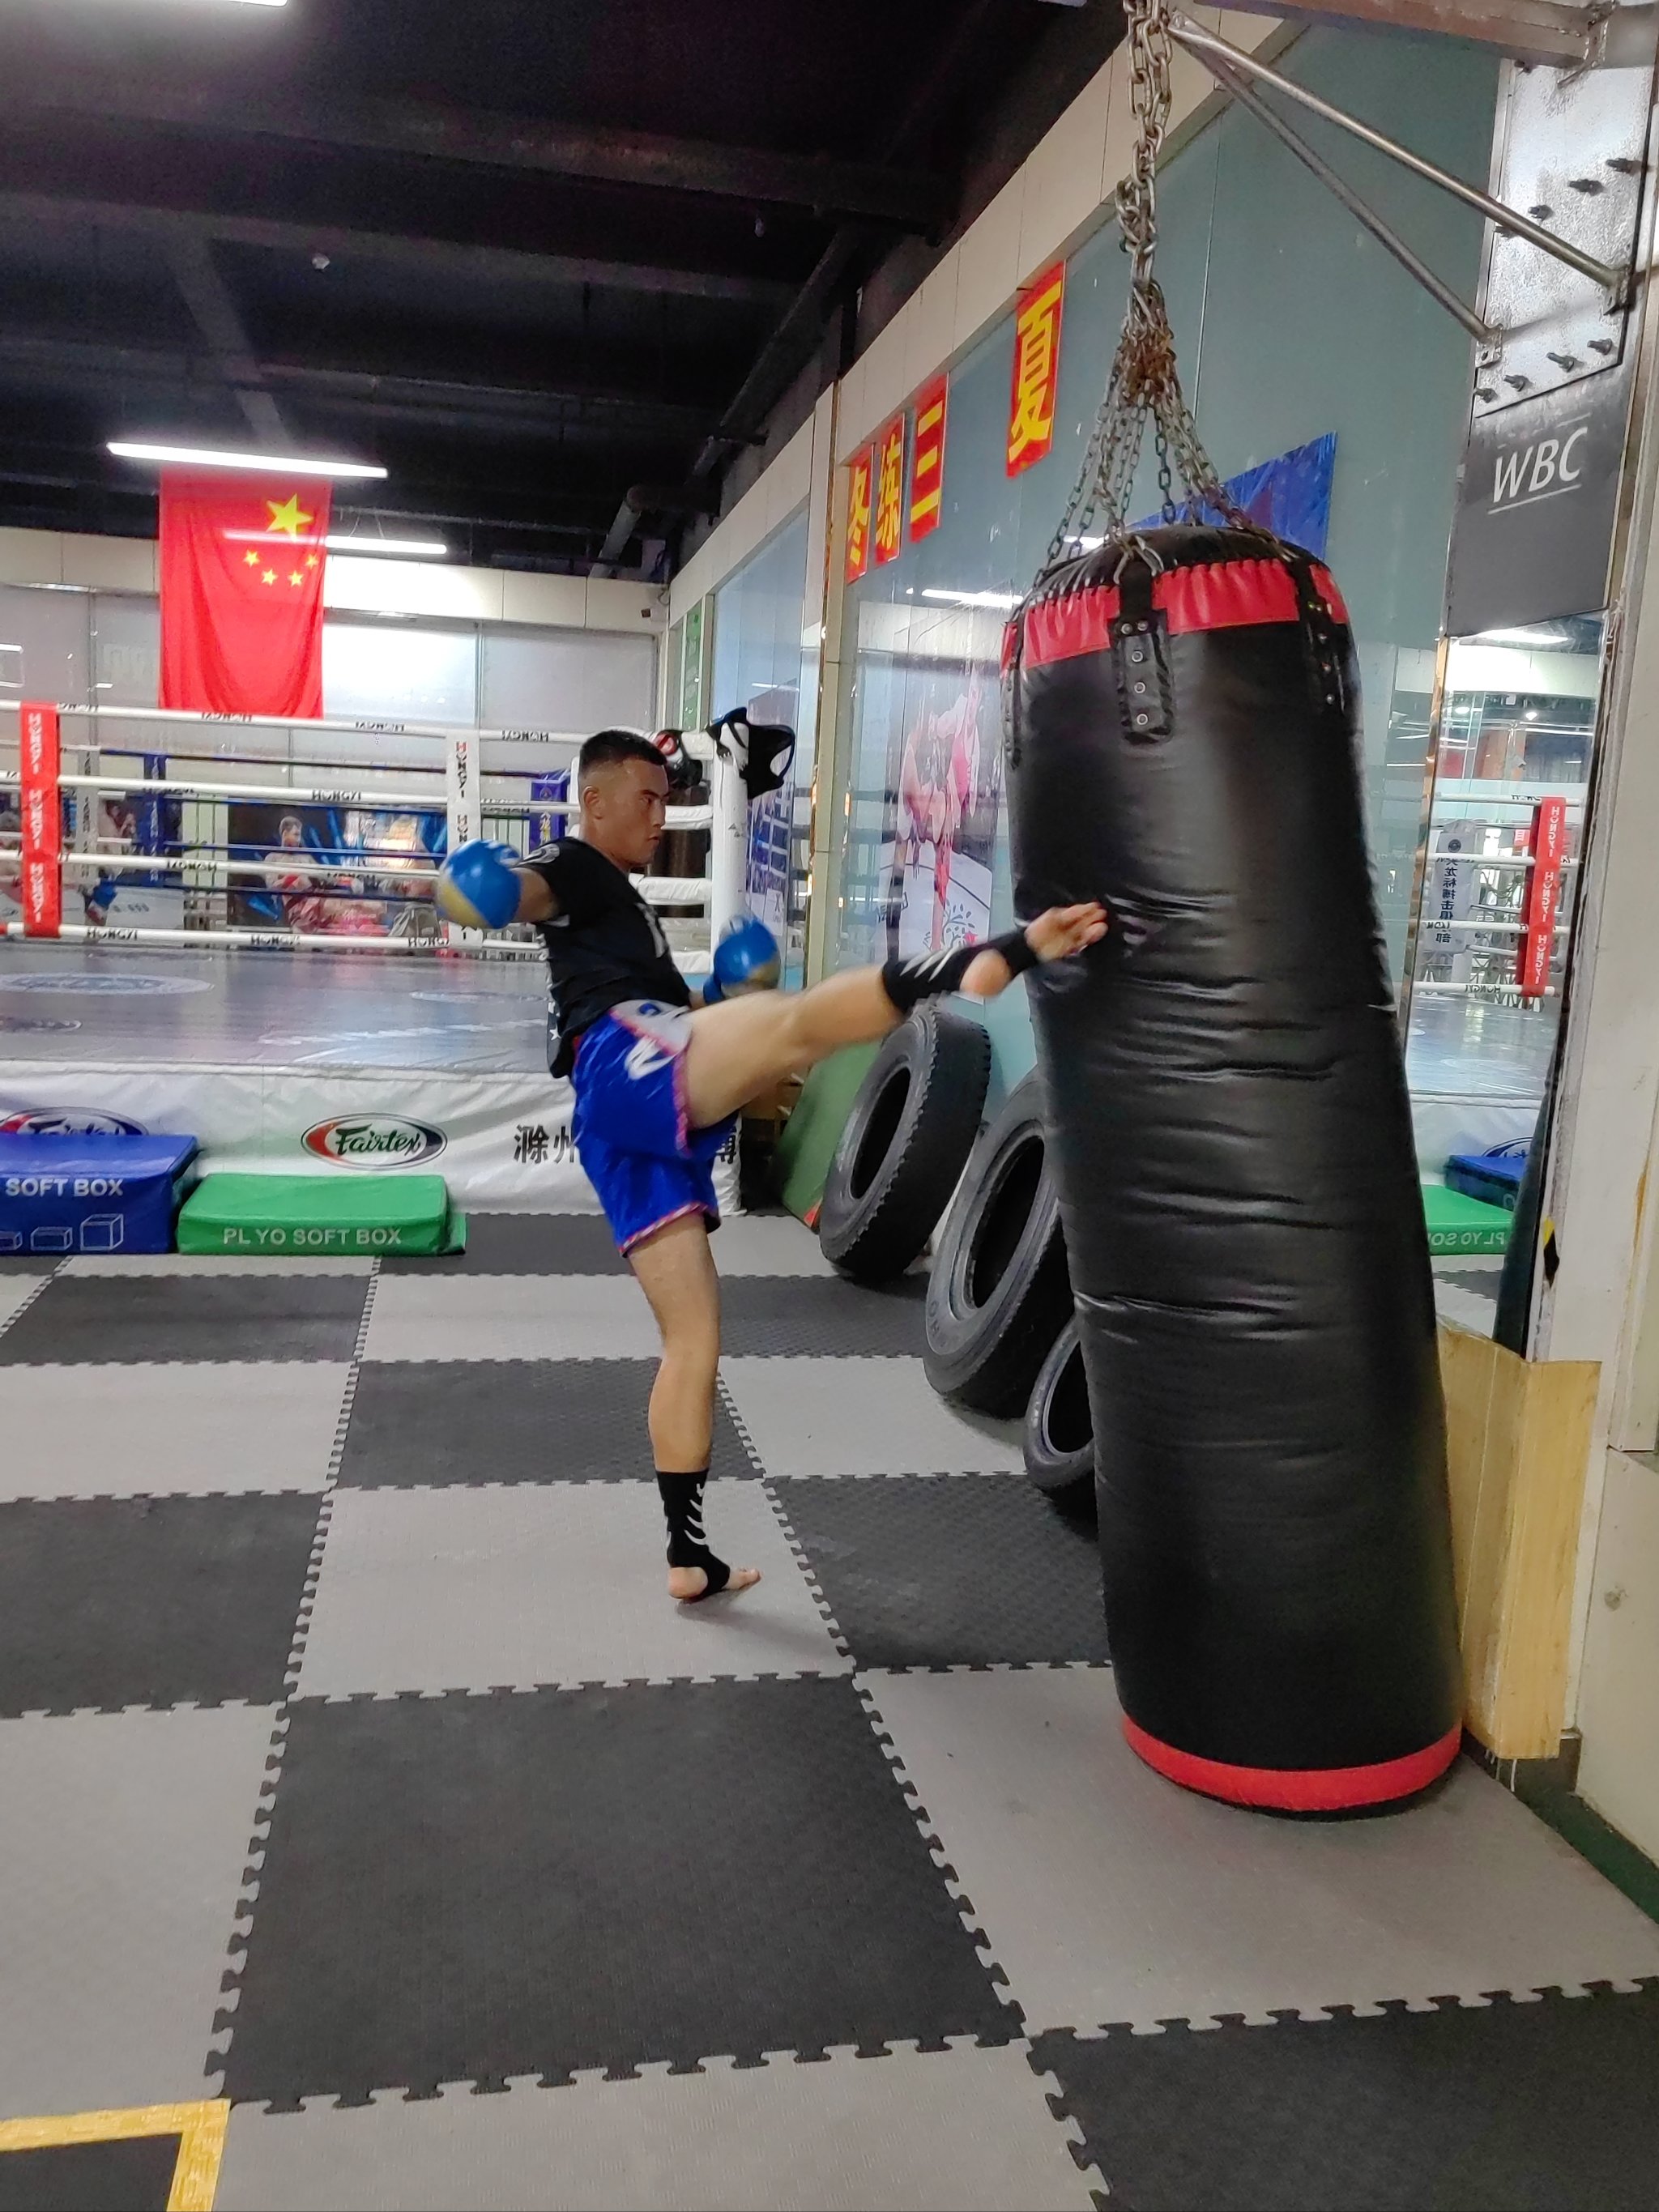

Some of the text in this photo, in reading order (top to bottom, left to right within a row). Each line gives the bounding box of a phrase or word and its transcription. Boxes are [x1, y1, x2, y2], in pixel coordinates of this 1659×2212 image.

[1493, 427, 1589, 503] WBC
[456, 741, 467, 799] HONGYI
[312, 788, 362, 802] HONGYI
[457, 814, 468, 843] HON
[335, 1123, 421, 1157] Fairtex
[6, 1177, 124, 1198] SOFT BOX
[292, 1228, 351, 1246] SOFT
[356, 1228, 403, 1246] BOX
